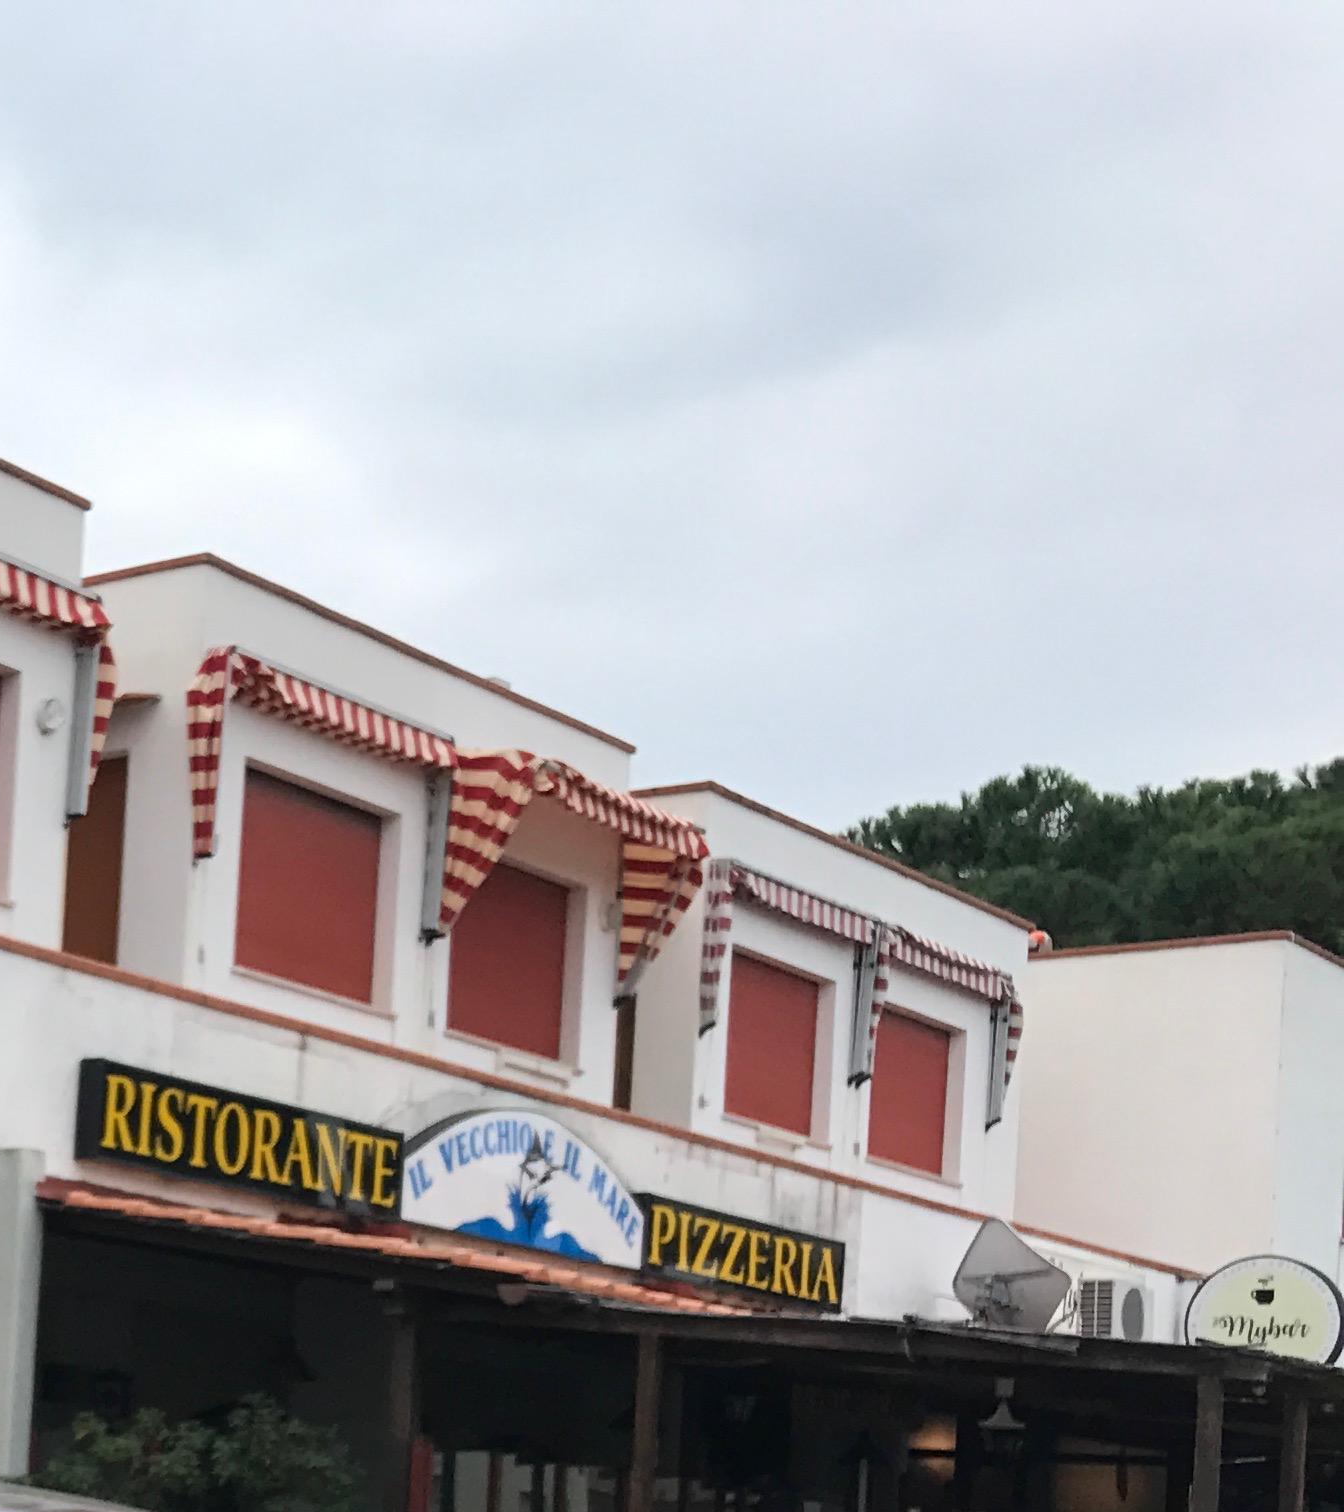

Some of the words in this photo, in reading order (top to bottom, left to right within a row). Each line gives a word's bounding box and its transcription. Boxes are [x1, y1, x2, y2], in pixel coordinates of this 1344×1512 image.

[101, 1074, 400, 1208] RISTORANTE
[407, 1159, 433, 1201] IL
[438, 1119, 534, 1175] VECCHIO
[543, 1129, 556, 1162] E
[562, 1138, 581, 1182] IL
[588, 1165, 640, 1249] MARE
[647, 1205, 839, 1304] PIZZERIA
